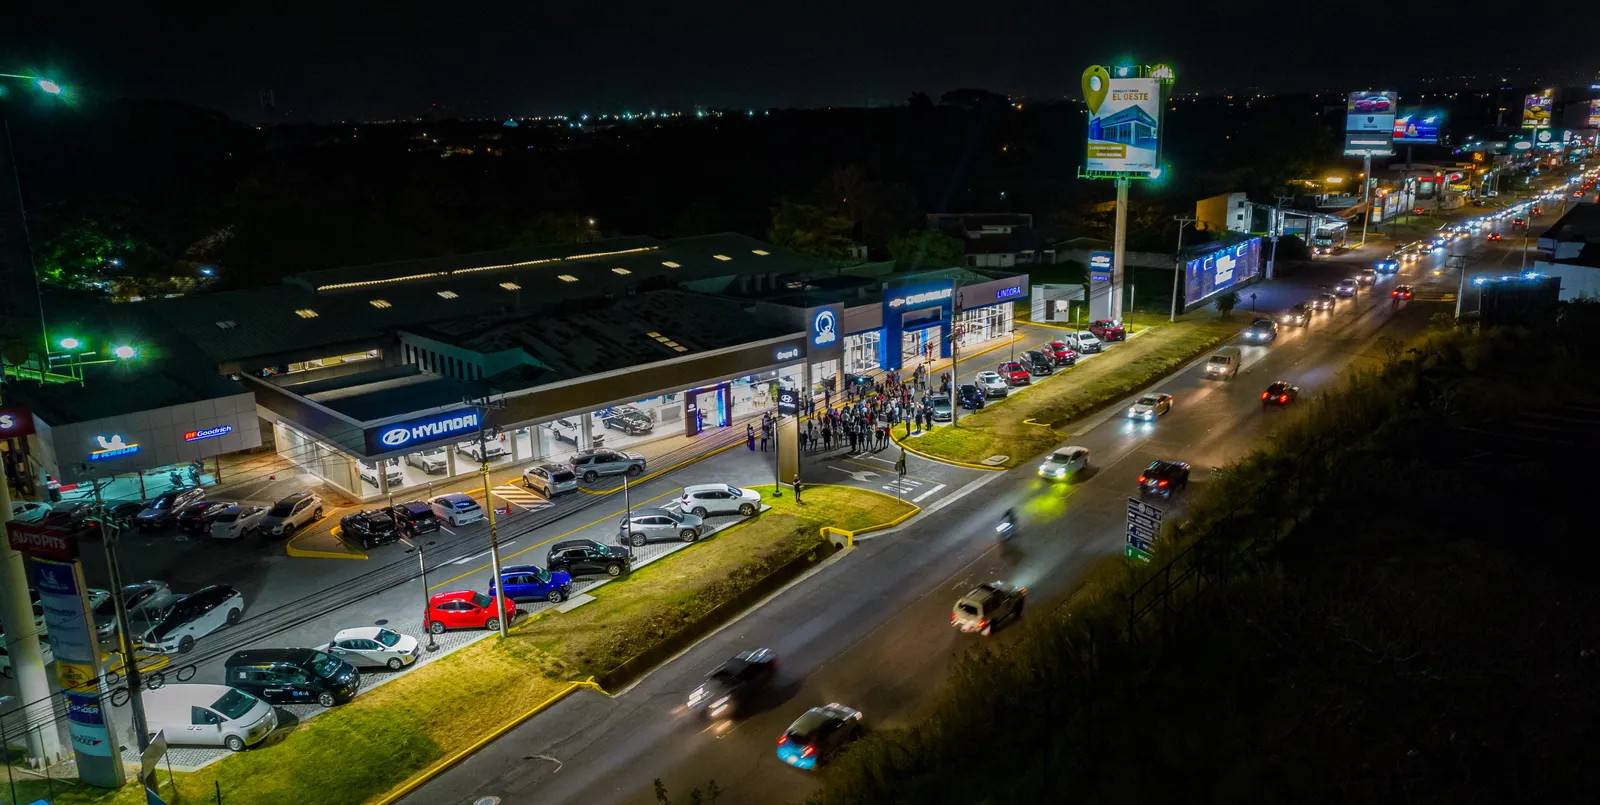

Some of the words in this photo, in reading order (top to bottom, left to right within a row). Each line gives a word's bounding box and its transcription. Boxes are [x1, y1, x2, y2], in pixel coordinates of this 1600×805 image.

[1112, 93, 1122, 101] EL
[1123, 92, 1148, 101] OESTE
[997, 286, 1021, 298] LINDORA
[412, 414, 477, 439] HYUNDAI
[12, 528, 66, 550] AUTOPITS
